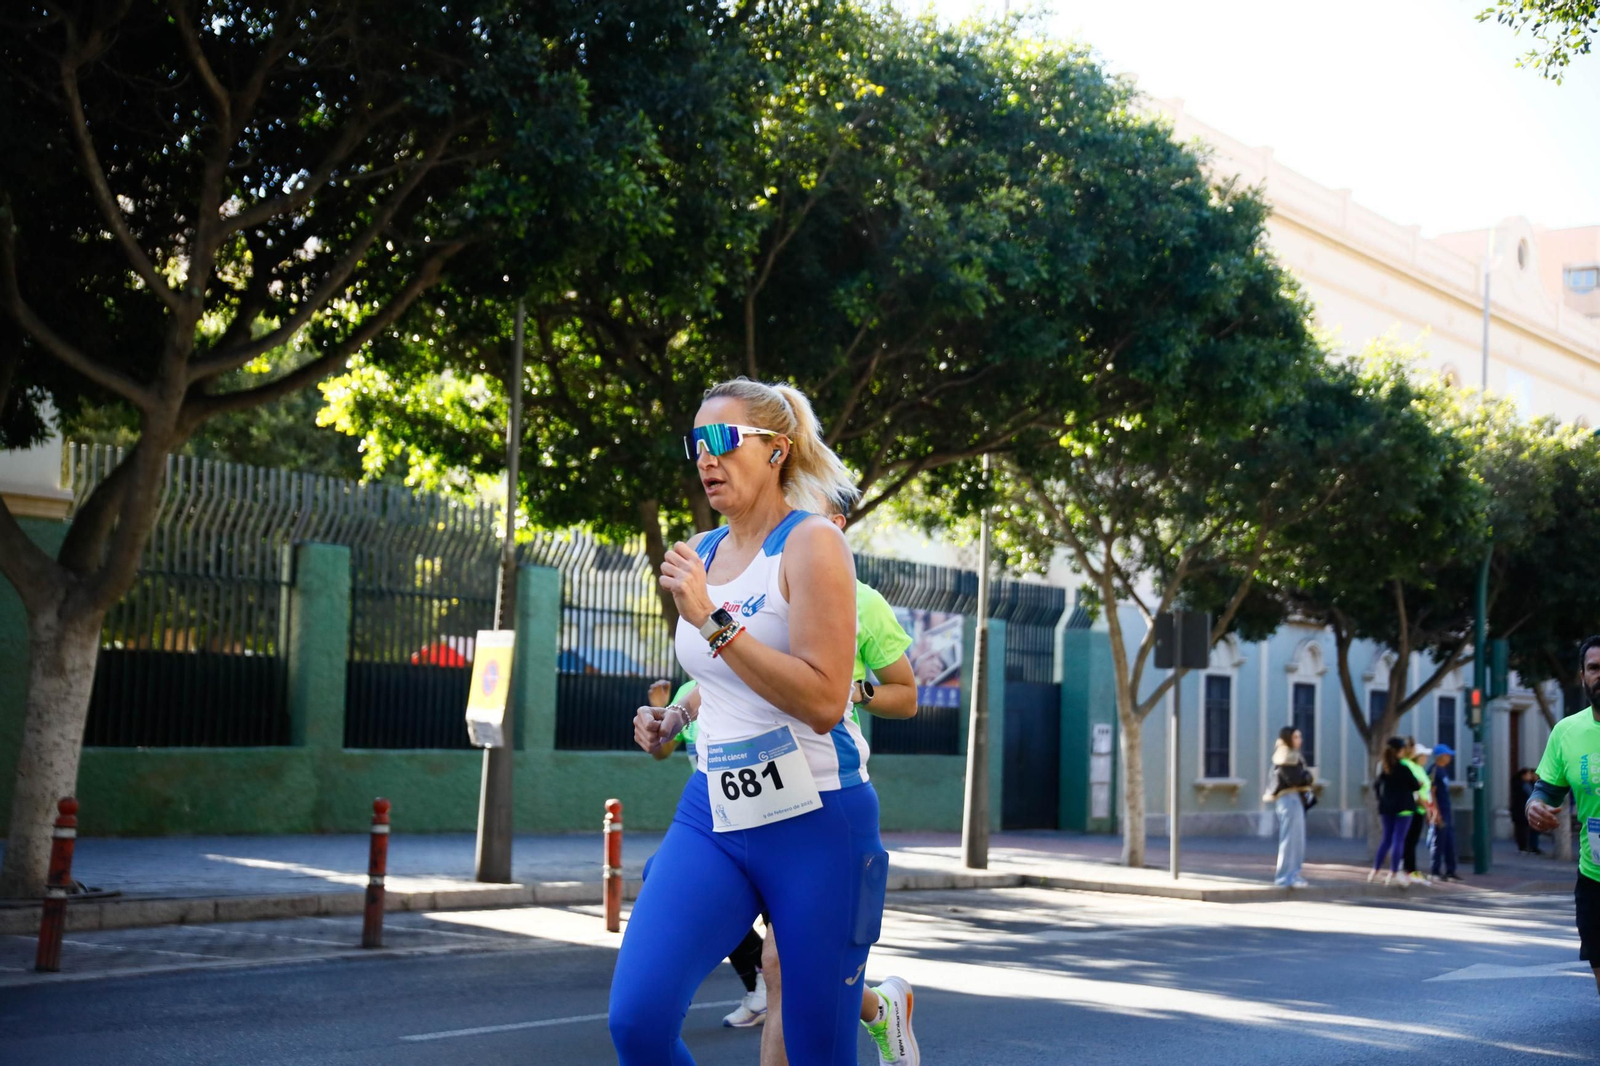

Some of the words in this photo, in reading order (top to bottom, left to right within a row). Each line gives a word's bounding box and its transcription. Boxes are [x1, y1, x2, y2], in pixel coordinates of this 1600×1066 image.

[722, 754, 727, 762] el
[727, 752, 748, 761] cáncer
[721, 760, 784, 800] 681
